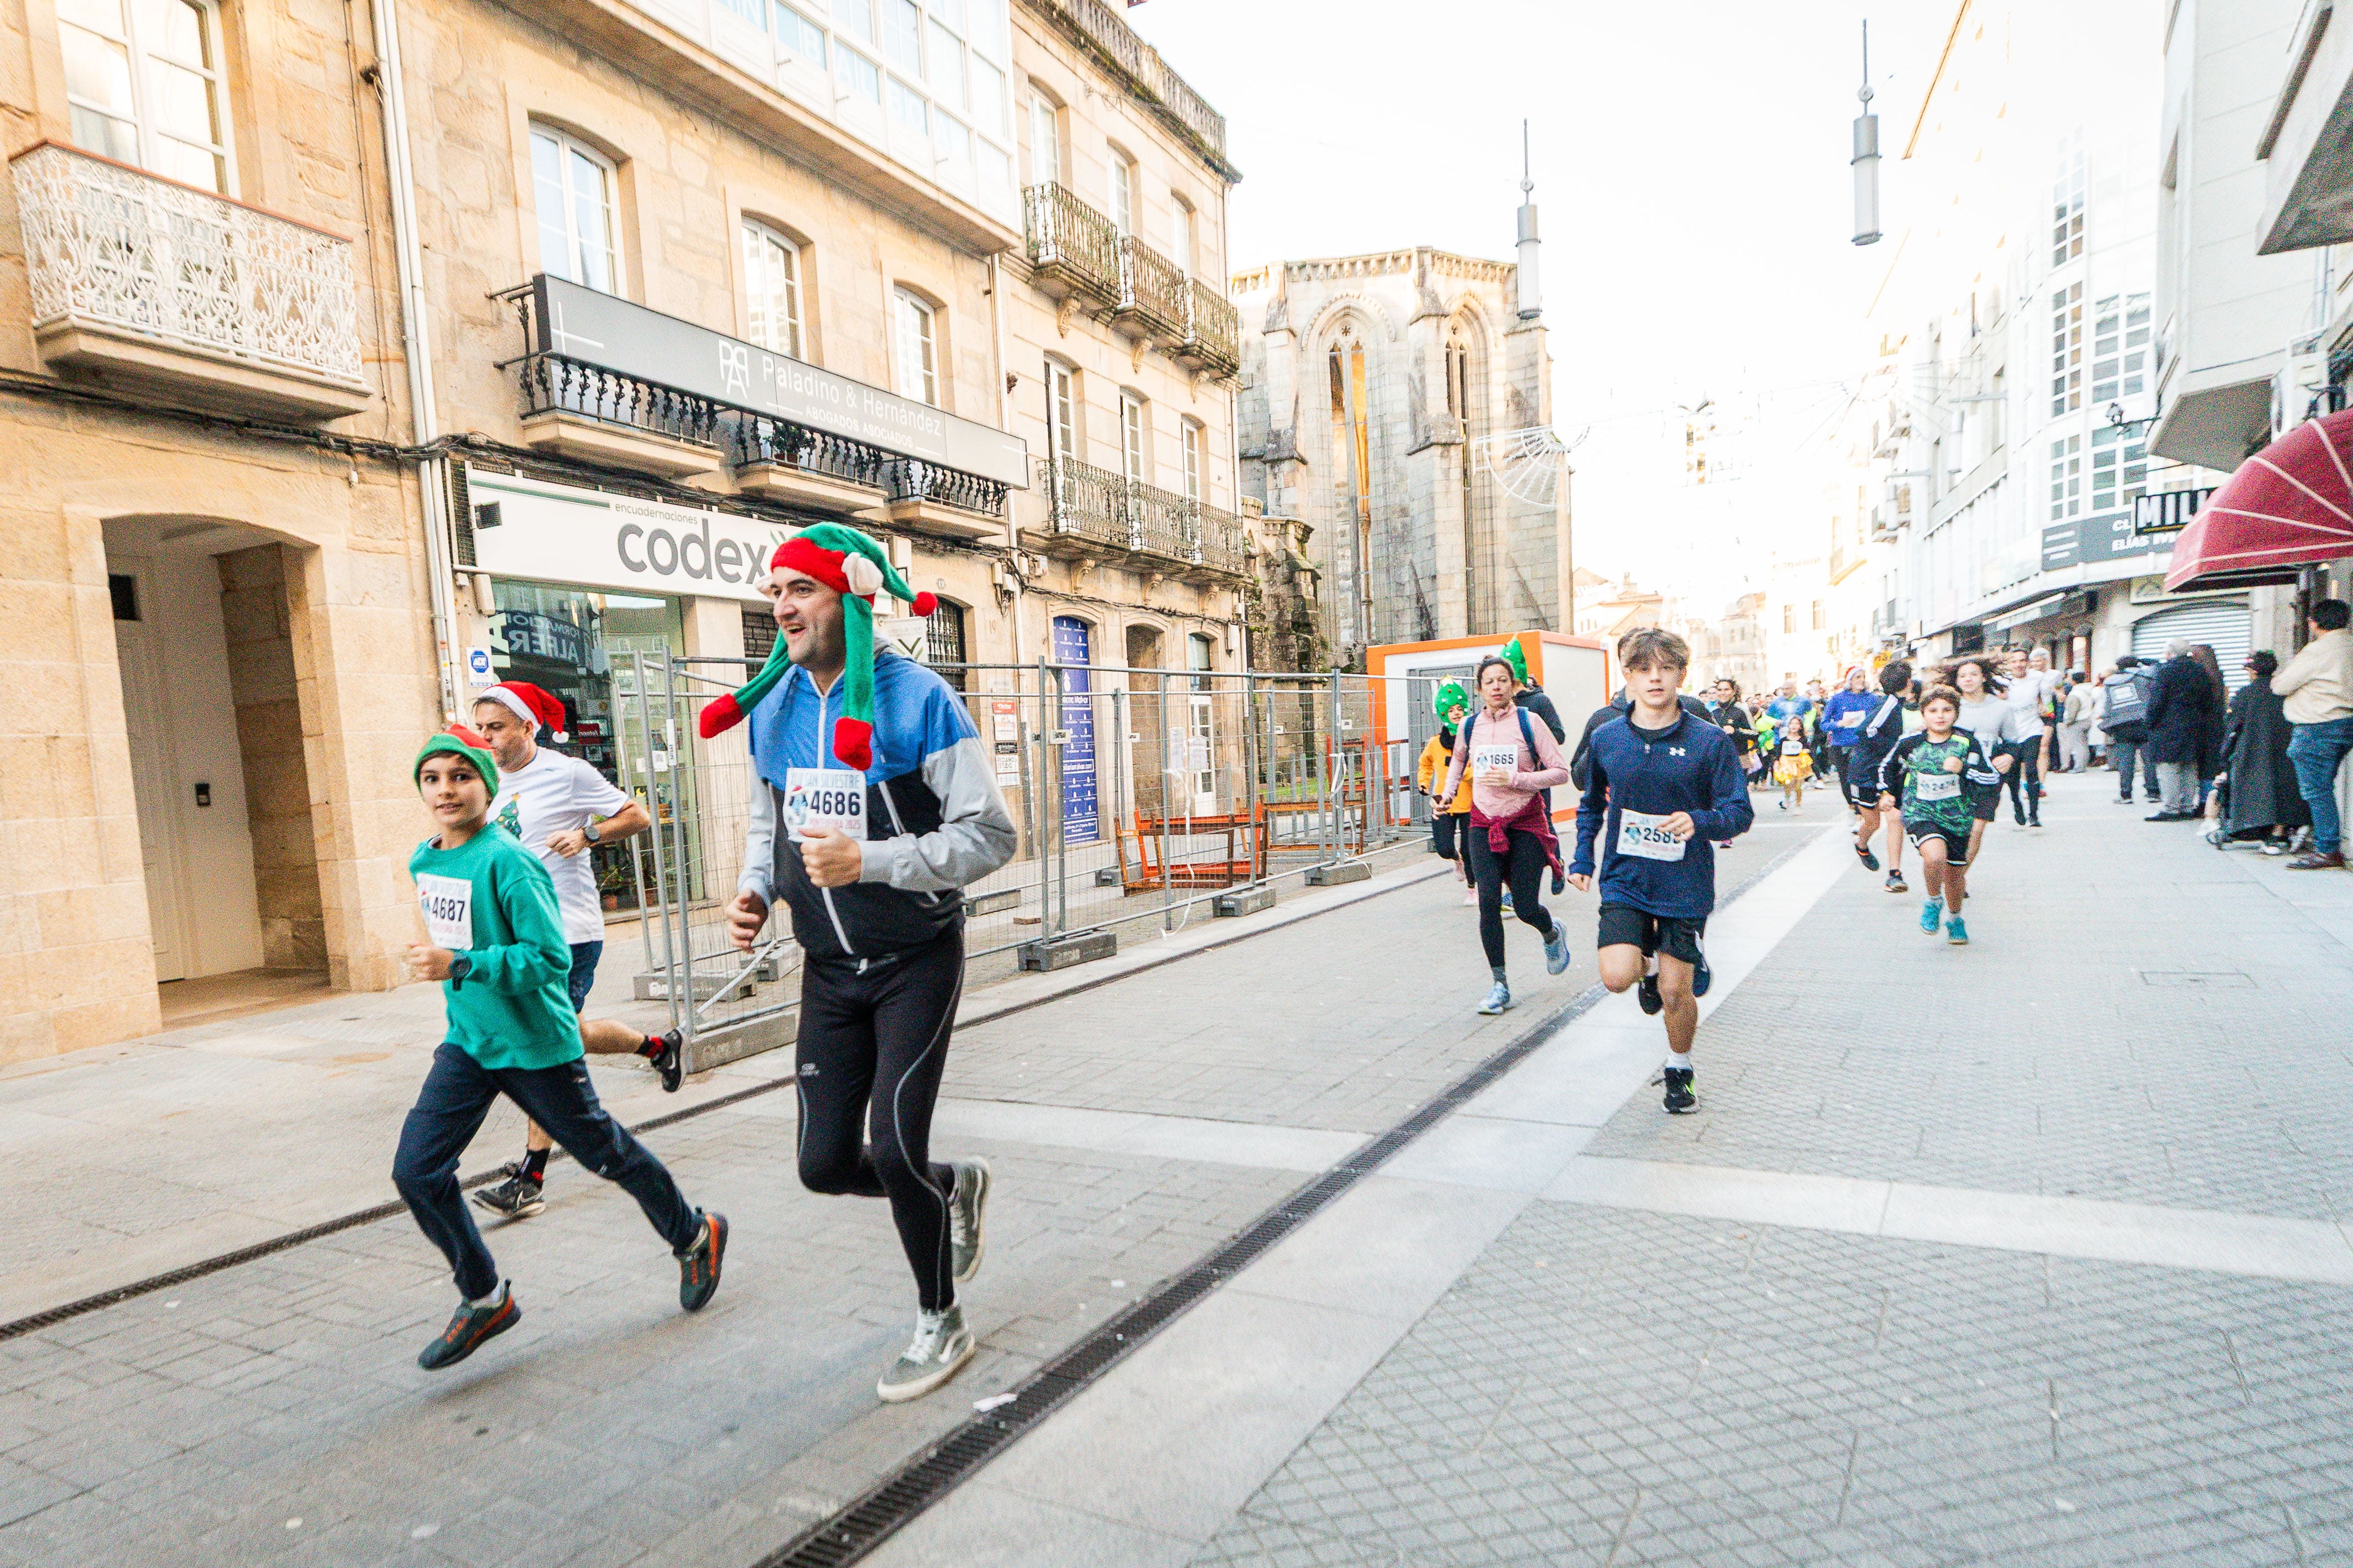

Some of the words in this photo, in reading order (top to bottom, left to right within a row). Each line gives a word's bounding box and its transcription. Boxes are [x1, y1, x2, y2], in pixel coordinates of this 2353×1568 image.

[762, 355, 840, 404] Paladino
[845, 384, 857, 409] &
[864, 389, 941, 436] Hernández
[806, 405, 859, 431] ABOGADOS
[862, 422, 914, 449] ASOCIADOS
[615, 502, 698, 525] encuadernaciones
[617, 517, 767, 584] codex
[1490, 754, 1514, 764] 1665
[821, 773, 860, 789] SILVESTRE
[811, 790, 860, 816] 4686
[432, 896, 466, 922] 4687
